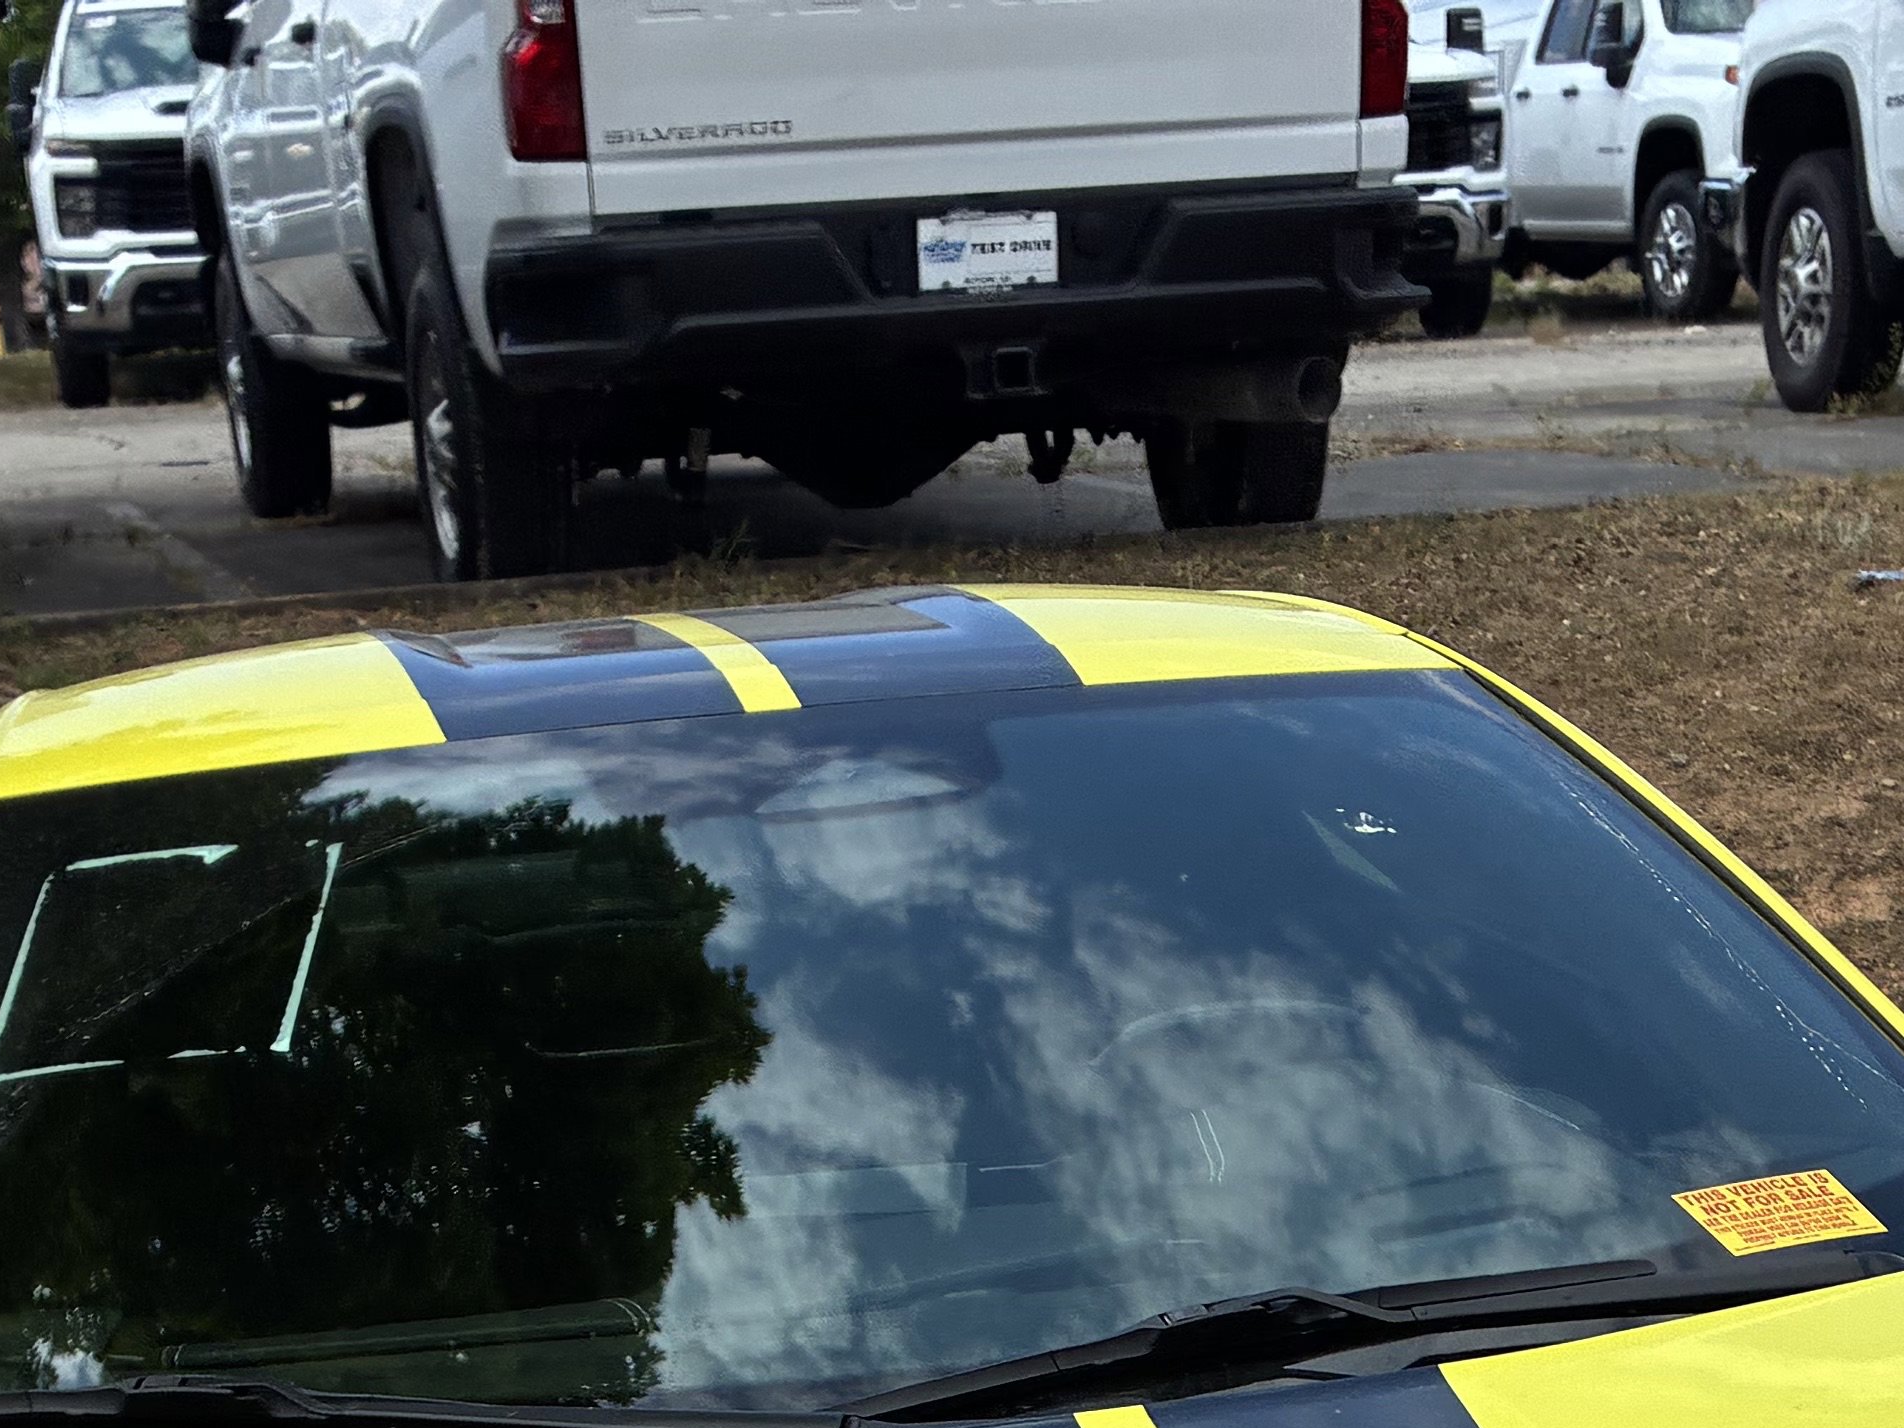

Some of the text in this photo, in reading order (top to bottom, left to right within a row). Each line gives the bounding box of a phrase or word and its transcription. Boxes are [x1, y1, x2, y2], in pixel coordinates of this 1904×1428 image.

[603, 120, 793, 144] SILVERADO
[1678, 1172, 1829, 1206] THIS VEHICLE IS
[1700, 1185, 1835, 1216] NOT FOR SALE
